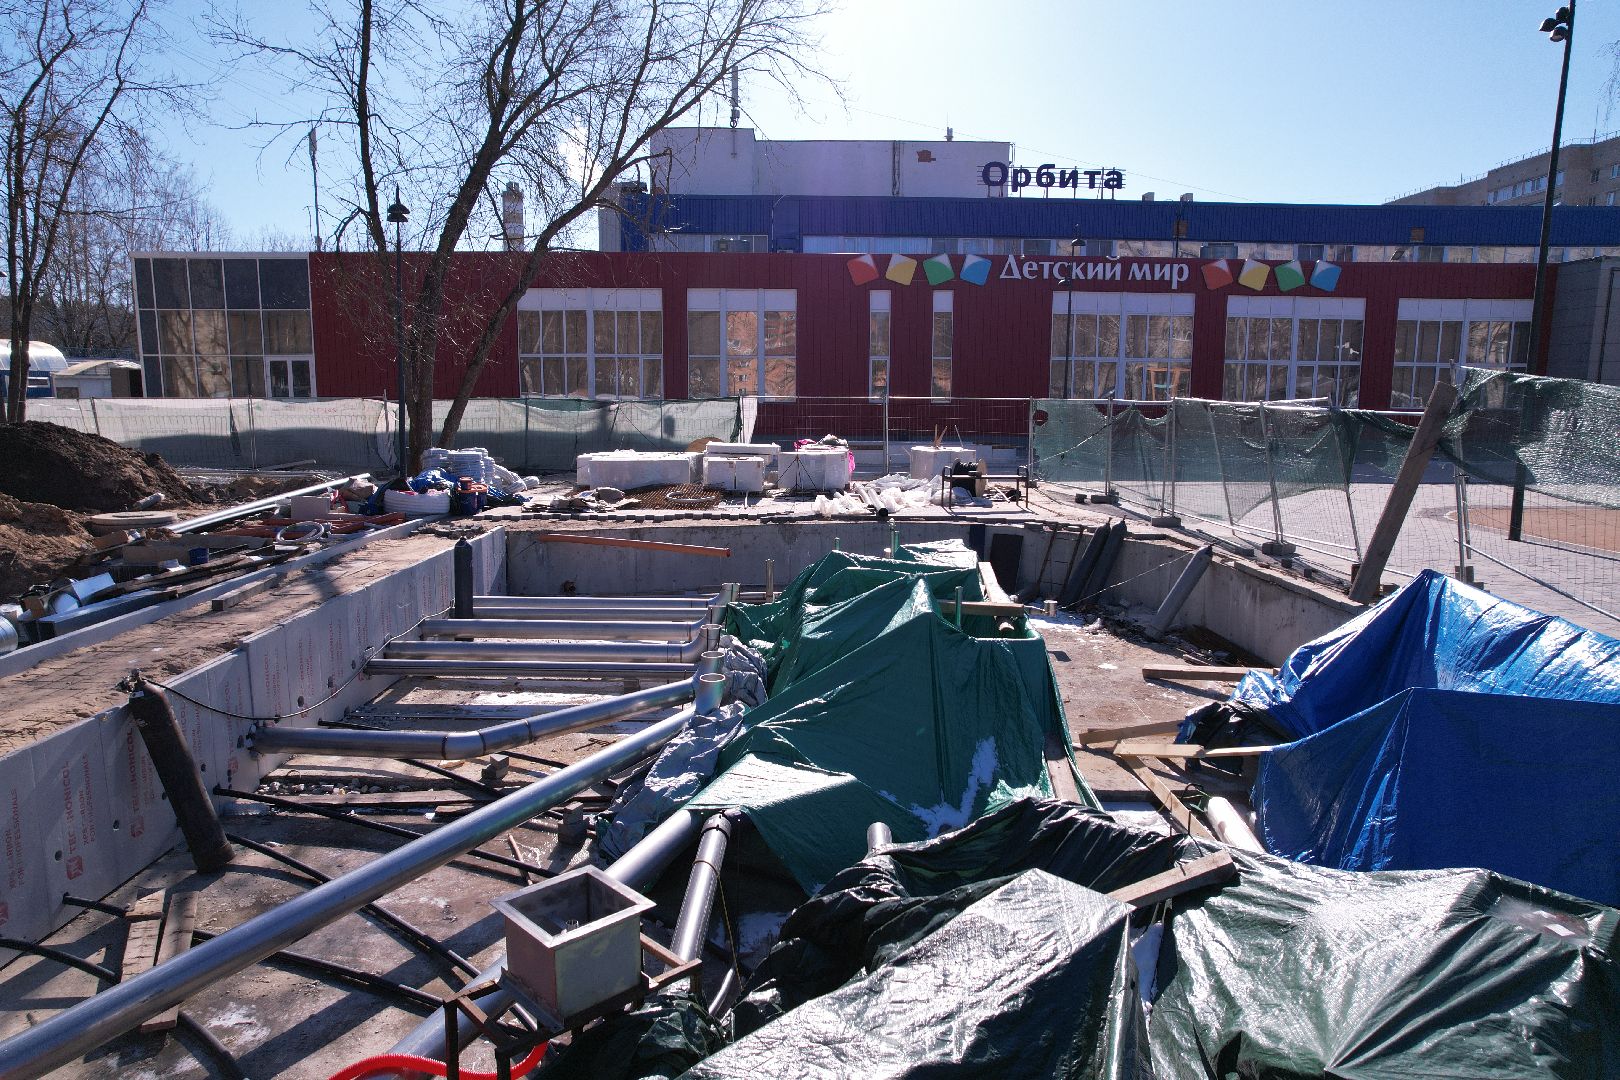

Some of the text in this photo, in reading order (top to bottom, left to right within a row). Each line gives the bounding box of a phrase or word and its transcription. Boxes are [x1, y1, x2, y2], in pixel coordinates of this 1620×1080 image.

[982, 161, 1123, 193] Орбита
[1000, 254, 1190, 290] Детский мир
[63, 760, 77, 854] TECNONICOL
